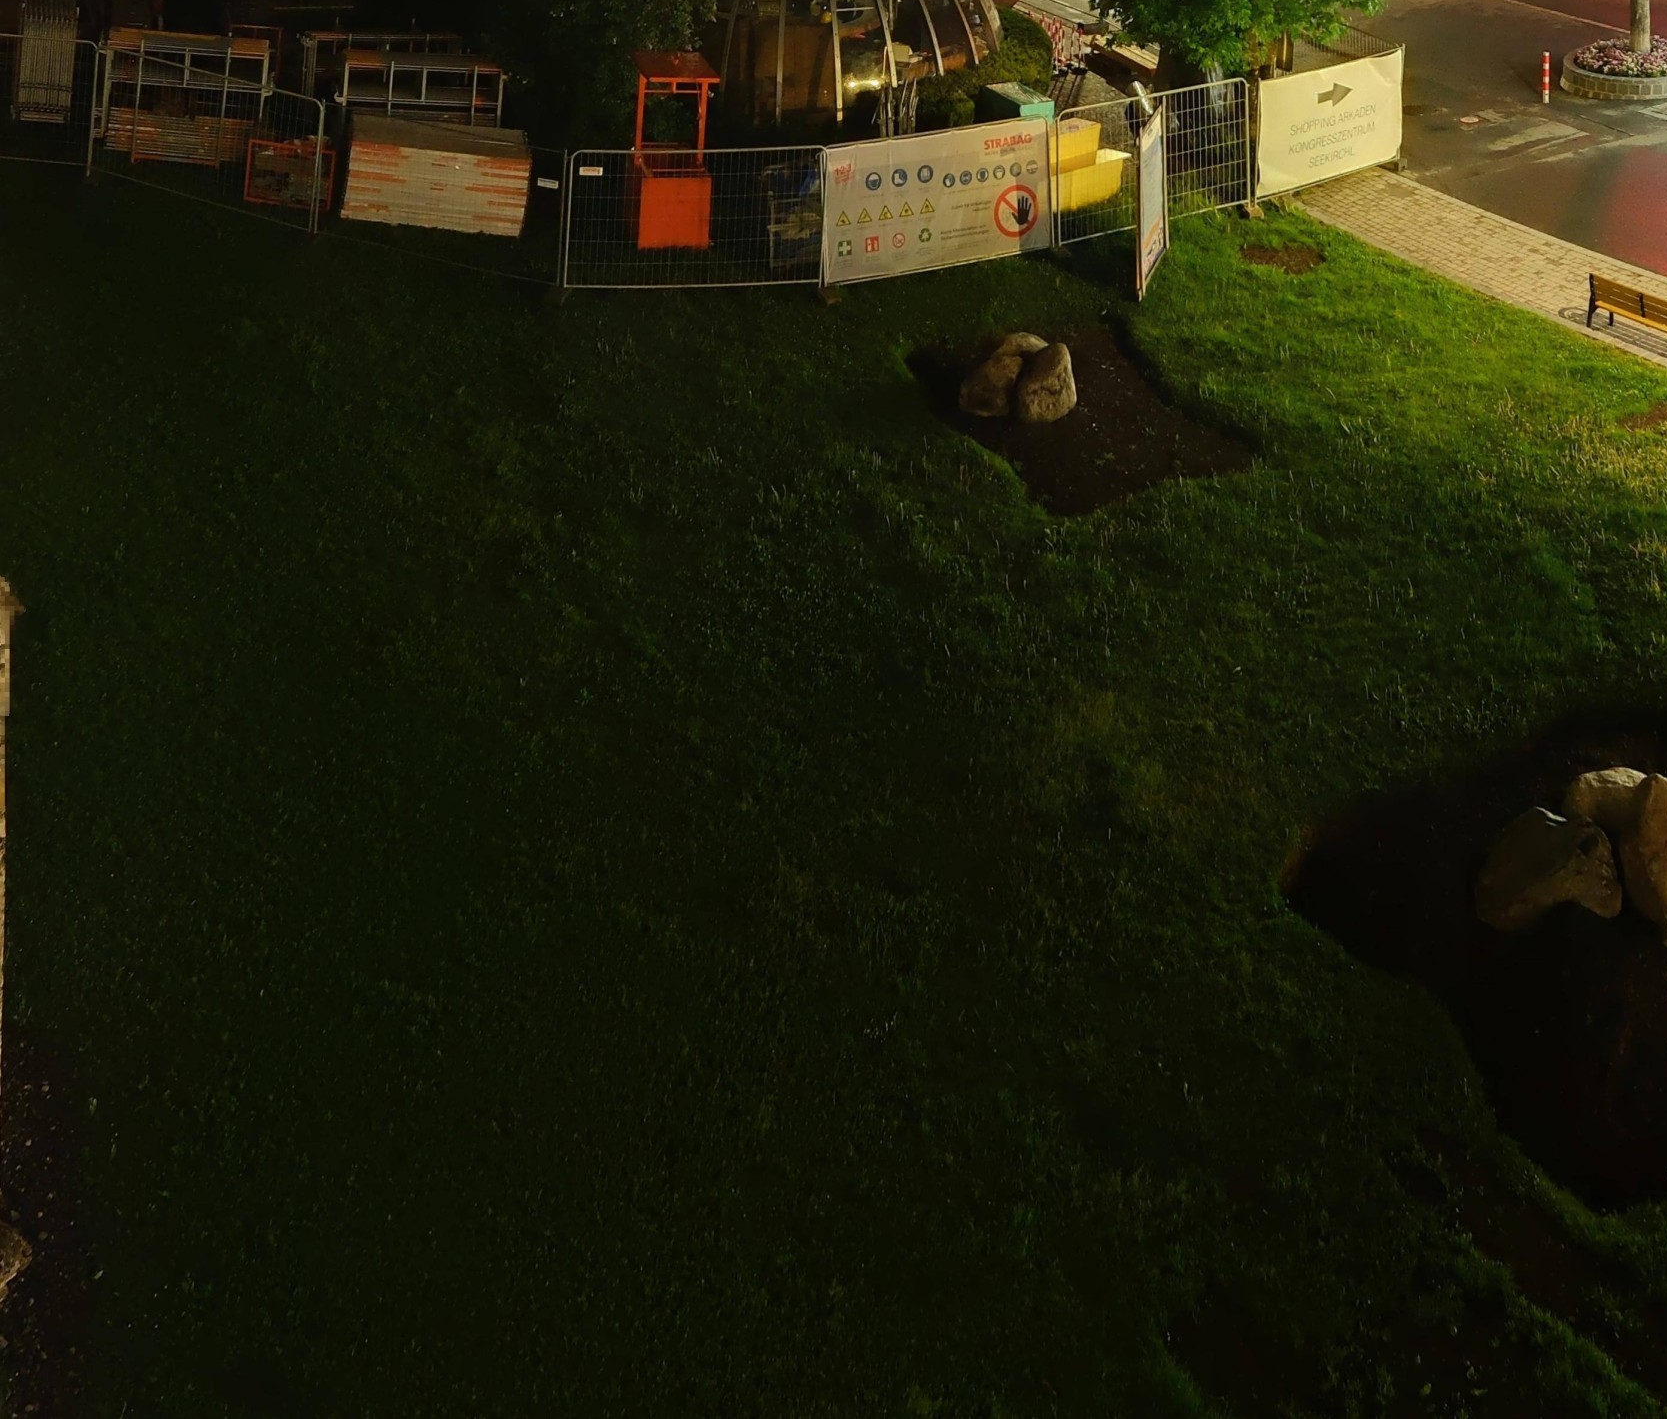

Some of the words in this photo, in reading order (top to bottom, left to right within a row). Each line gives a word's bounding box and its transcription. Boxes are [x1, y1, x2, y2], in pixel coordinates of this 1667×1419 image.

[1290, 115, 1337, 136] SHOPPING
[1338, 104, 1377, 124] ARKADEN
[984, 133, 1032, 150] STRABAG
[1288, 121, 1376, 156] KONGRESSZENTRUM
[1308, 146, 1355, 169] SEEKIRCHL
